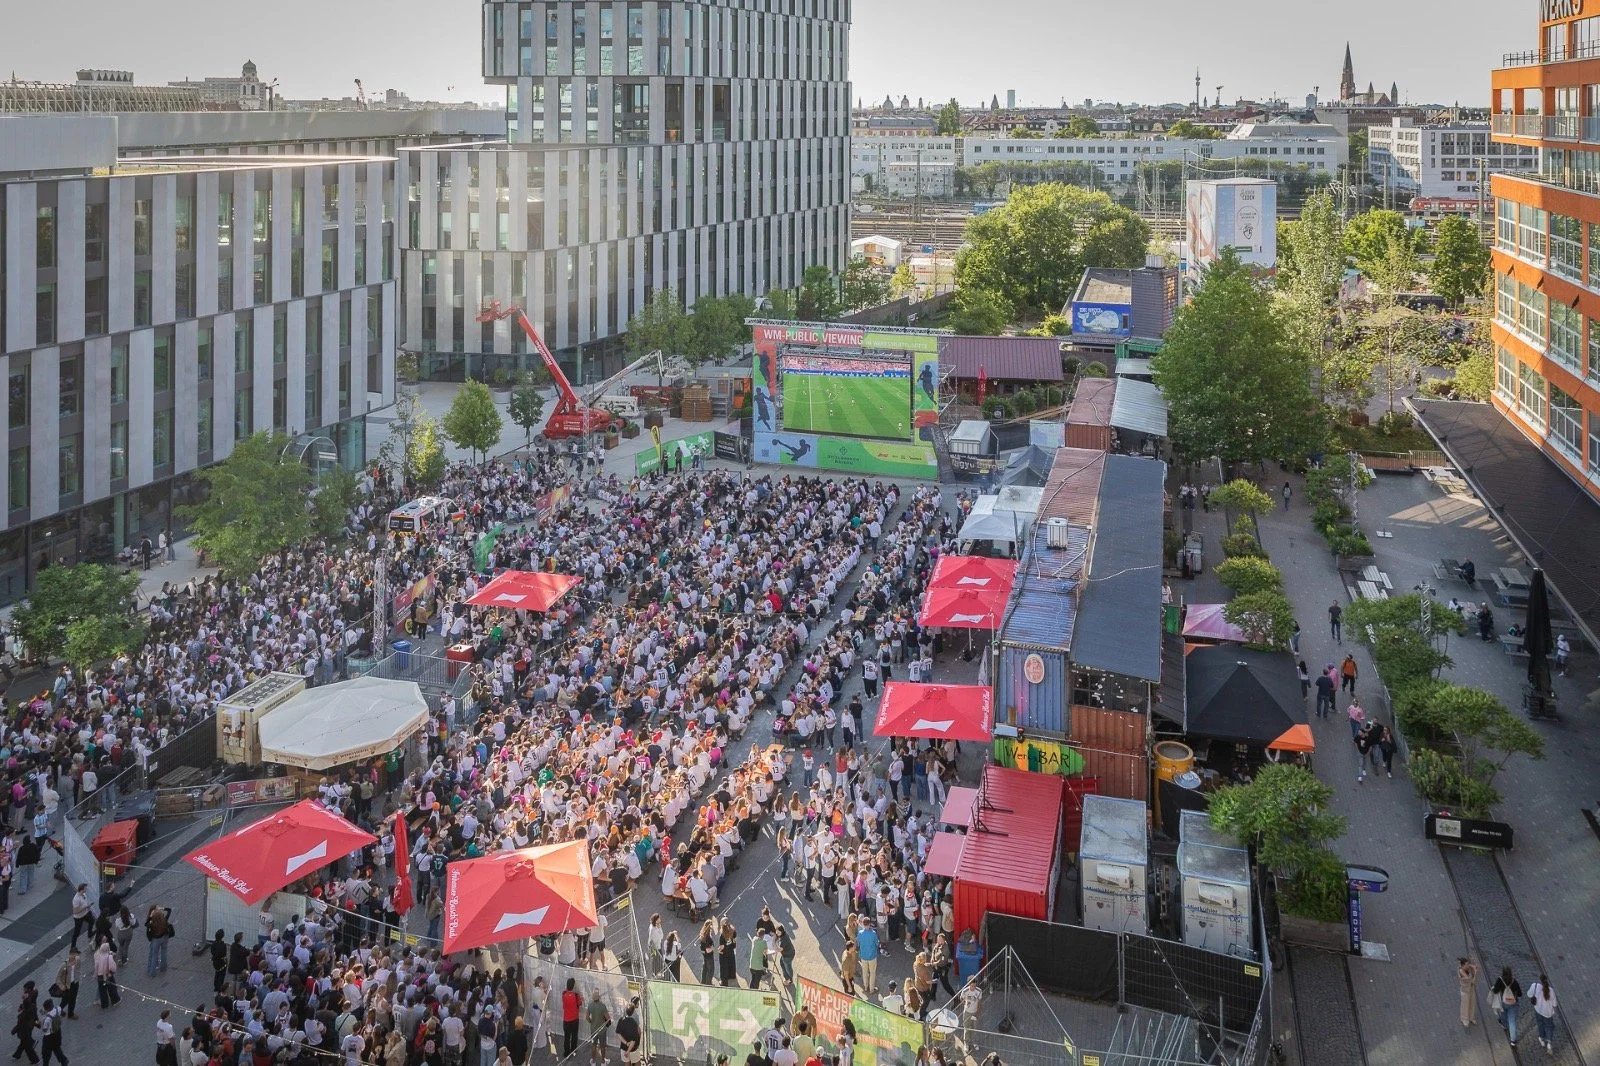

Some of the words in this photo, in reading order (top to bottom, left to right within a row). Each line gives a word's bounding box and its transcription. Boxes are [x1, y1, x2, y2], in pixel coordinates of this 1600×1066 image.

[763, 329, 819, 343] WM-PUBLIC
[823, 332, 864, 345] VIEWING
[1038, 749, 1070, 768] BAR
[772, 766, 779, 774] 13
[234, 879, 253, 895] Bud
[799, 983, 867, 1021] WM-PUBLIC
[769, 1037, 779, 1050] 10
